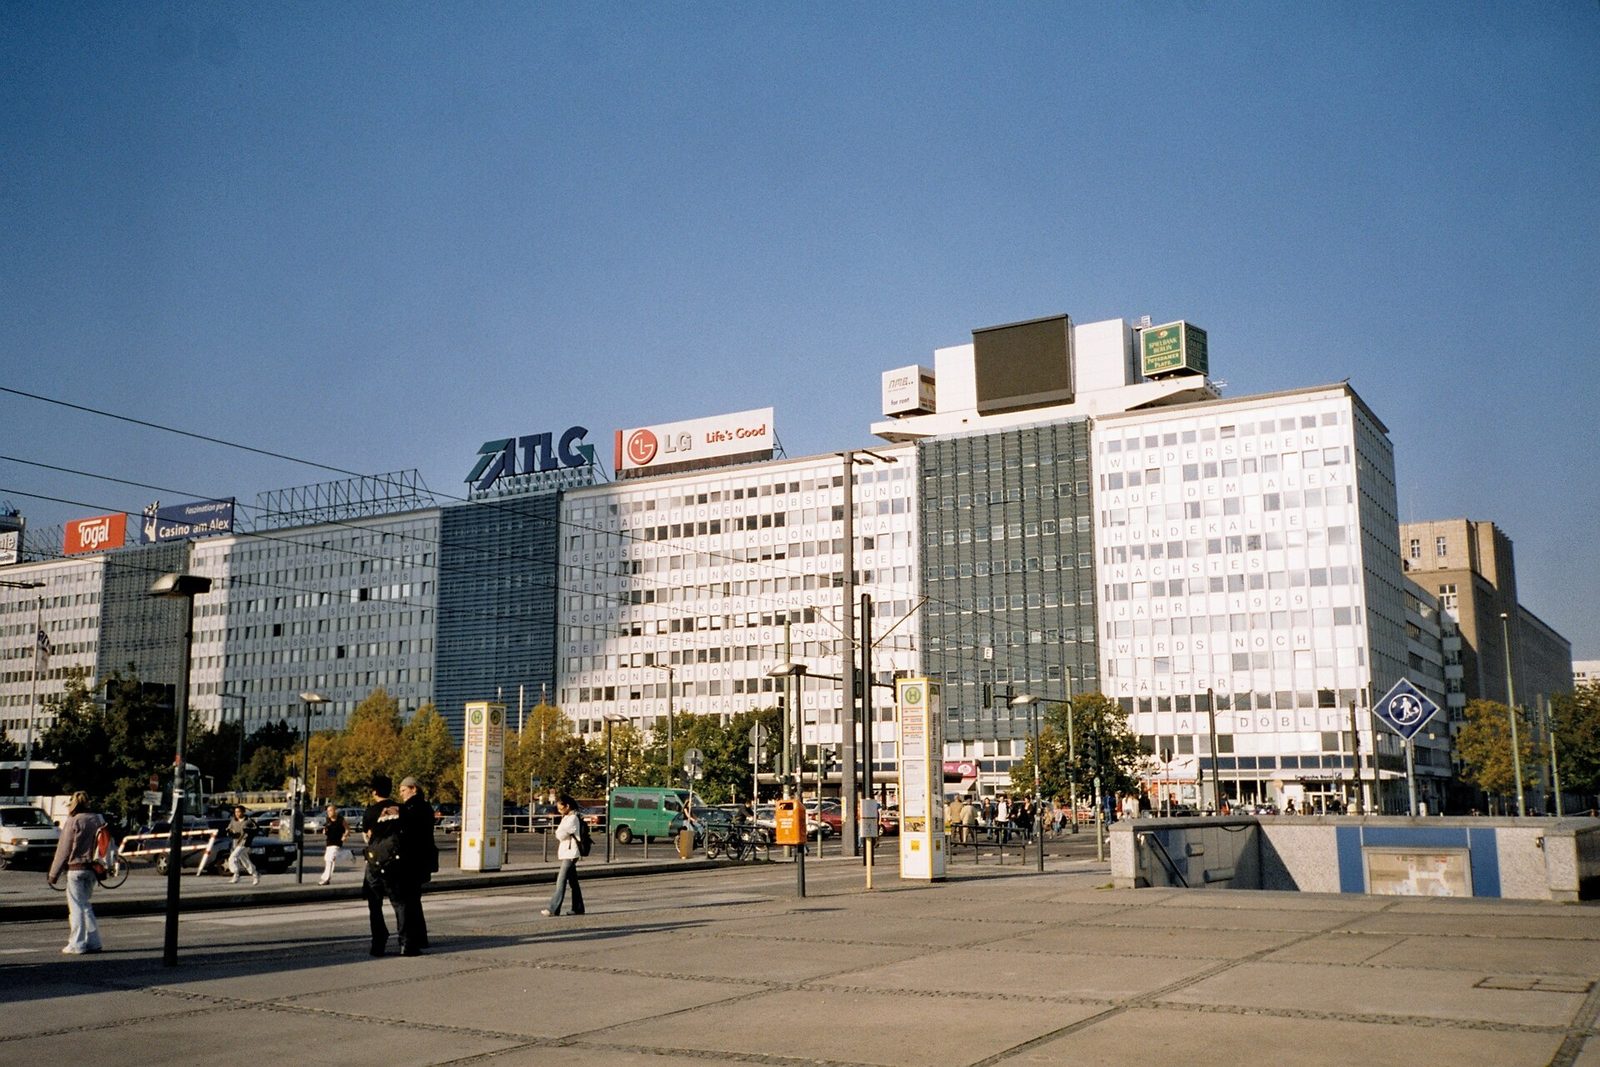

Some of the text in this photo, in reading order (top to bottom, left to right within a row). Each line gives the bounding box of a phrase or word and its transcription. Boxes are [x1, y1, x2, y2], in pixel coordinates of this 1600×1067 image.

[663, 424, 766, 454] LG Life's Good
[1110, 434, 1315, 469] WIEDERSEHEN
[864, 485, 902, 499] UND
[1112, 471, 1339, 505] AUF DEM ALEX
[78, 518, 110, 550] Togal
[159, 517, 229, 538] Casino am Alex
[403, 543, 431, 555] ZUM
[351, 573, 410, 587] RECHTS
[571, 582, 604, 593] REN
[620, 576, 654, 589] UND
[284, 609, 318, 620] SIND
[338, 629, 386, 643] STEHT
[632, 631, 771, 649] ANFERTIGUNG
[1118, 634, 1307, 654] WIRDS NOCH
[327, 660, 354, 672] DIE
[366, 656, 406, 670] SIND
